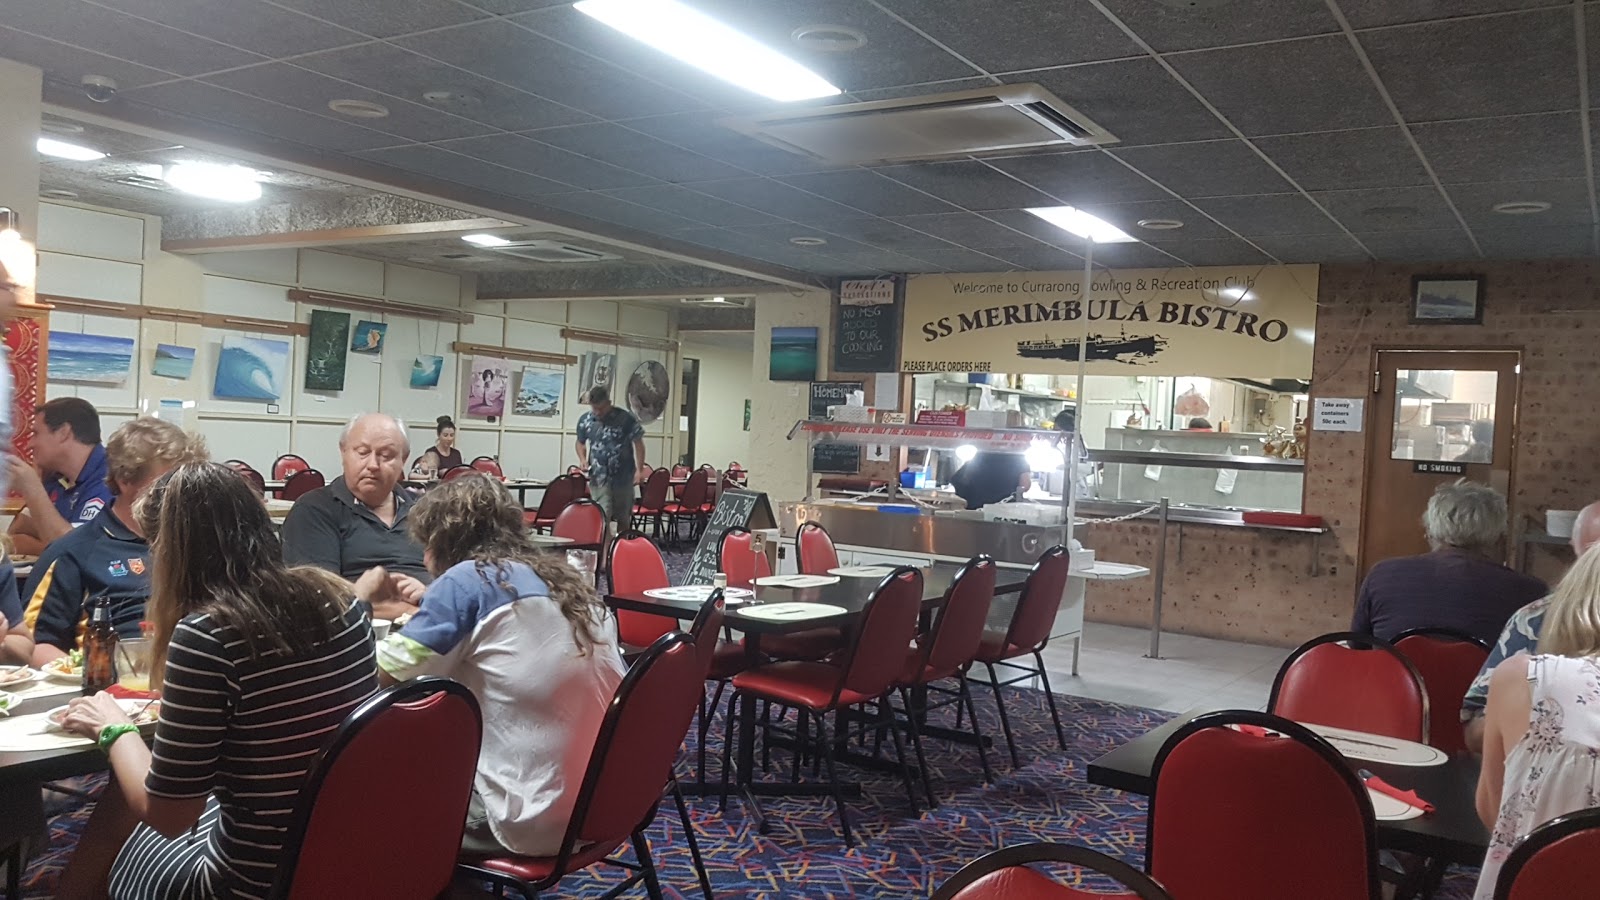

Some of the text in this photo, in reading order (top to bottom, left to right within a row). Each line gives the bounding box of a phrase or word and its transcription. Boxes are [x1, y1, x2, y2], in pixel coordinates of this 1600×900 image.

[953, 276, 1256, 295] Welcome to Currarong owling & Recreation Club
[843, 306, 881, 318] NO MSG
[922, 299, 1289, 343] SS MERIMBULA BISTRO
[844, 330, 879, 341] TO OUR
[842, 340, 883, 353] COOKING
[903, 360, 992, 372] PLEASE PLACE ORDERS HERE
[1430, 464, 1462, 473] SMOKING
[82, 509, 96, 517] DH
[755, 534, 762, 543] 5
